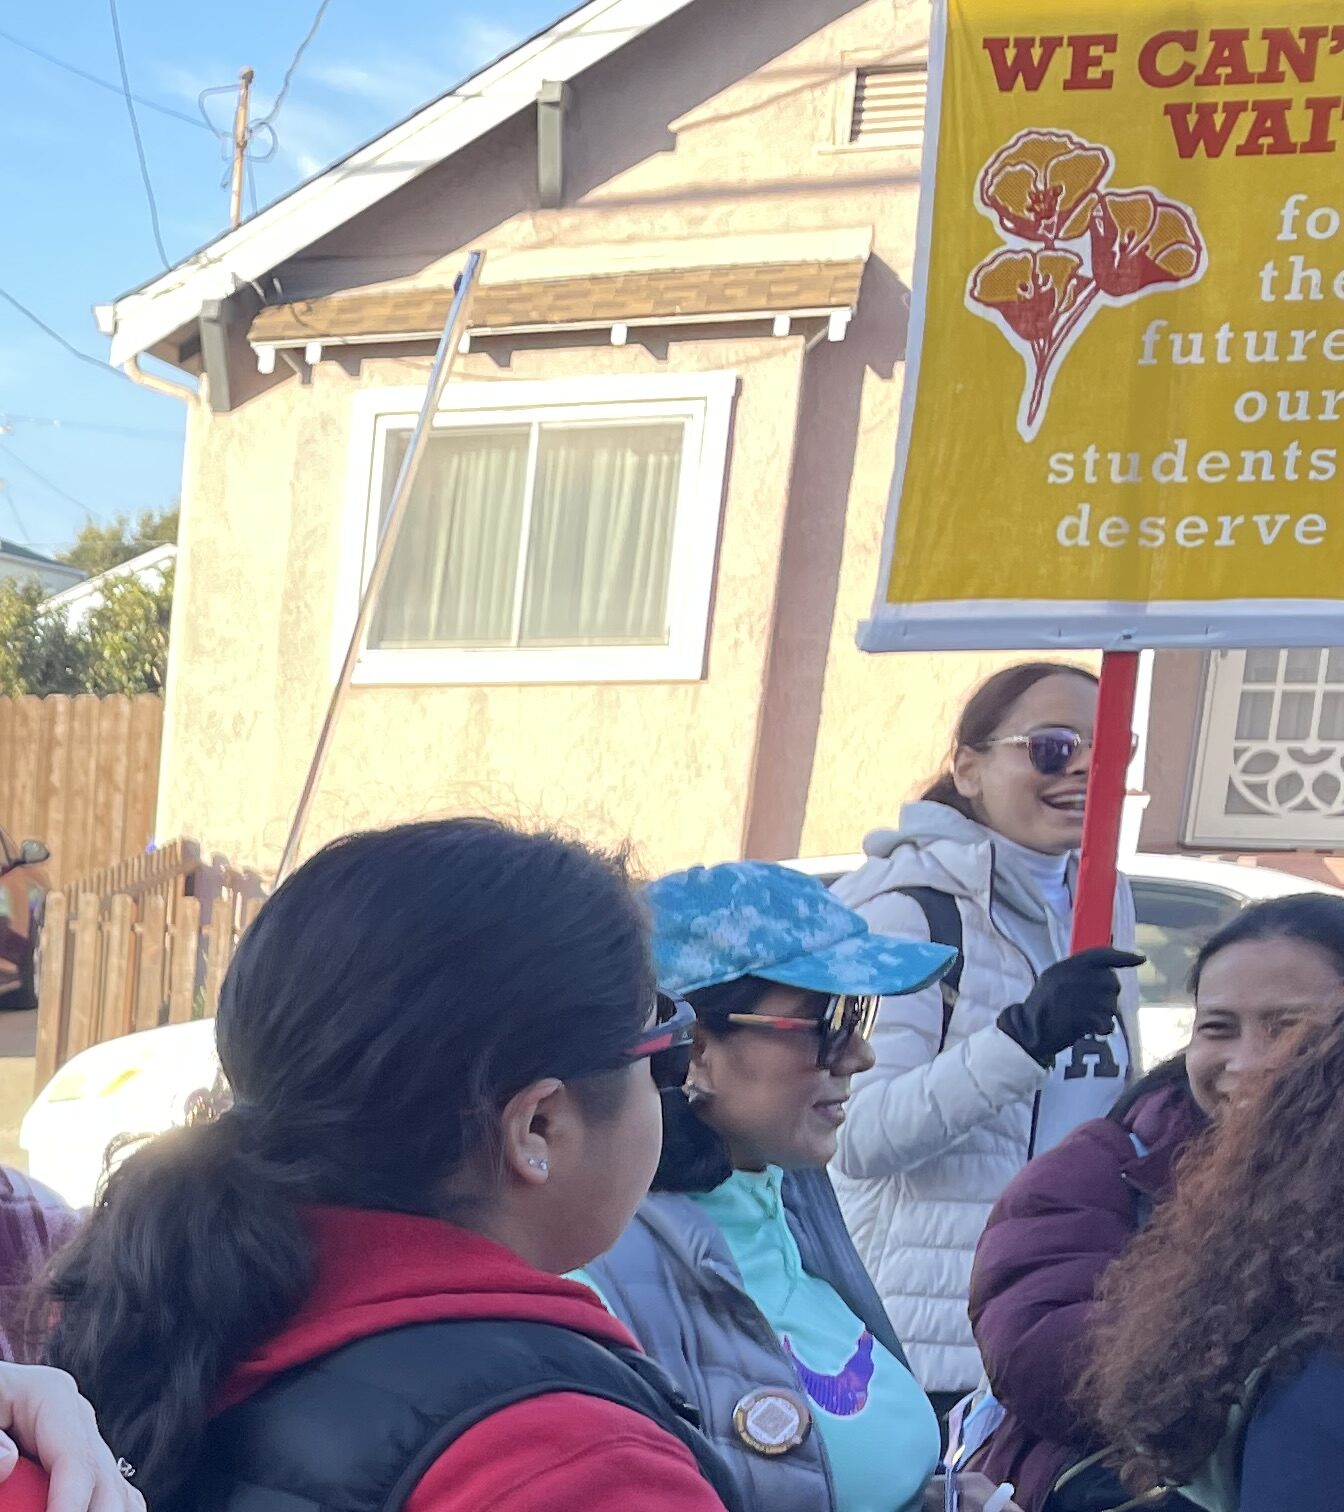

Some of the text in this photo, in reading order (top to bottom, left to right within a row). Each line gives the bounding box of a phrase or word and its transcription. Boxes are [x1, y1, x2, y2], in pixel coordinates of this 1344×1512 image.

[982, 34, 1118, 92] WE
[1164, 96, 1344, 158] WAI
[1235, 387, 1344, 424] our
[1048, 439, 1337, 484] students
[1057, 504, 1328, 549] deserve
